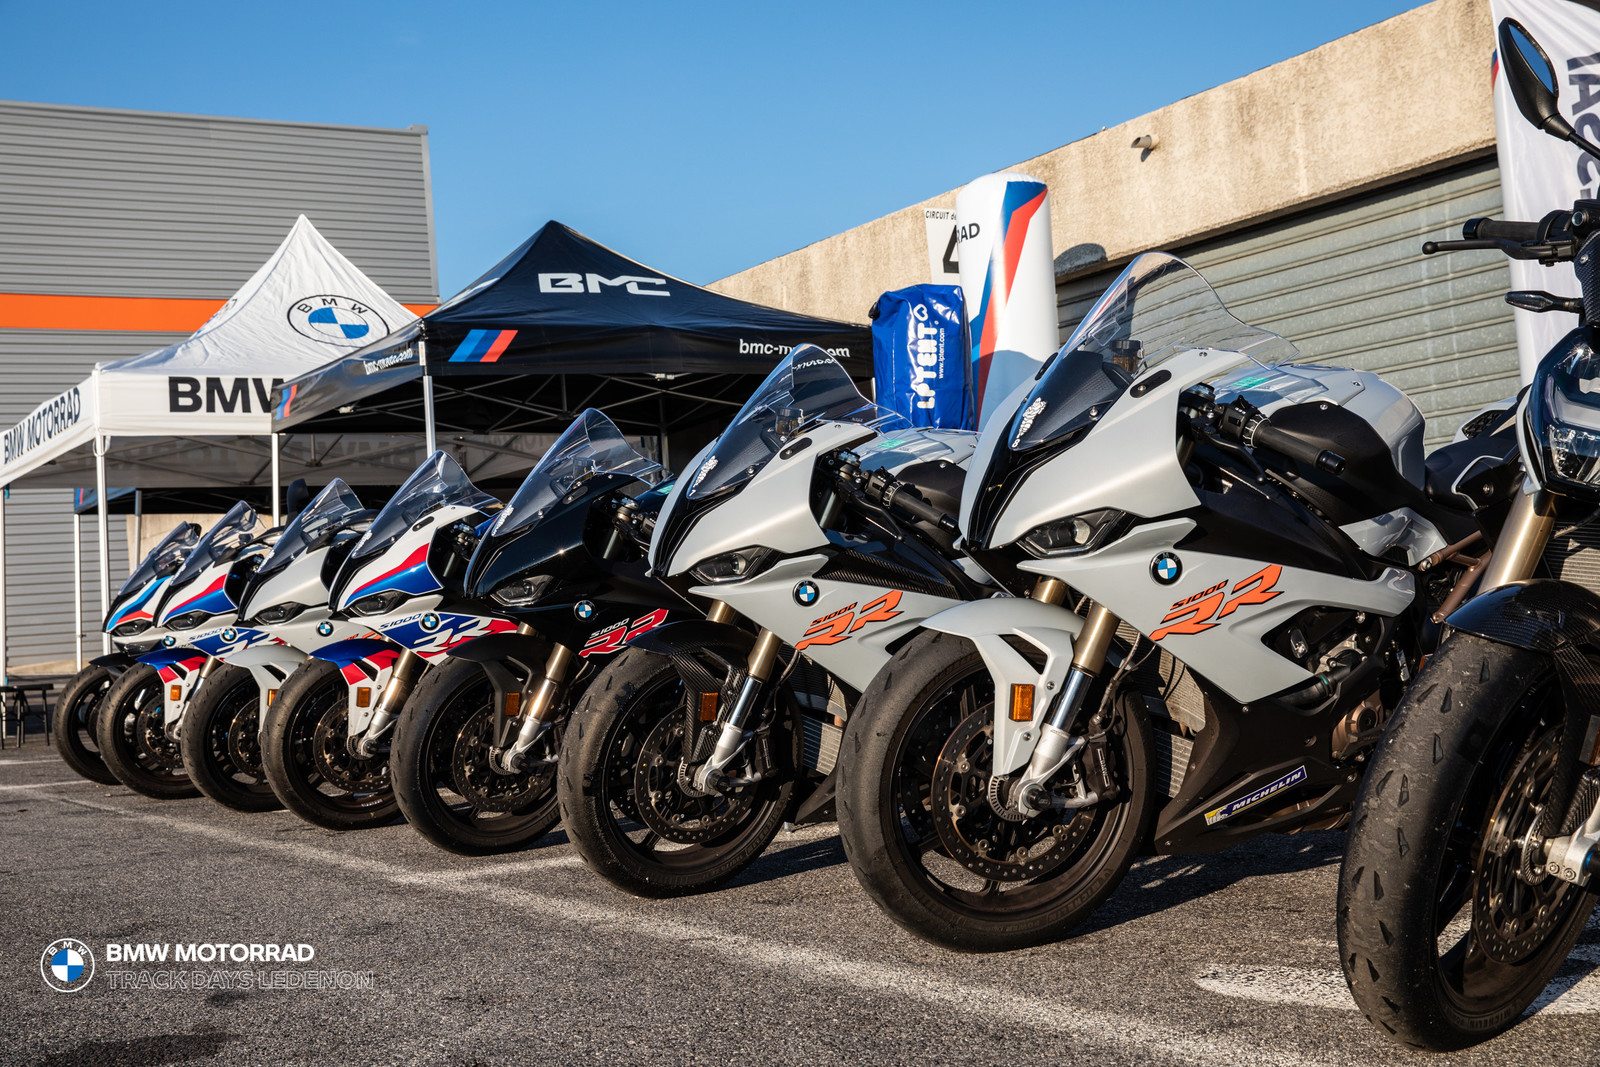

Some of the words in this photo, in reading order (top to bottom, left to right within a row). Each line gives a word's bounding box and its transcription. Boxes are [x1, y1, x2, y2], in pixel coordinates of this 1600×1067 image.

[925, 210, 950, 220] CIRCUIT
[538, 272, 671, 297] BMC
[297, 297, 368, 315] BMW
[3, 422, 26, 465] BMW
[26, 386, 81, 452] MOTORRAD
[1150, 565, 1284, 642] RR
[1169, 579, 1229, 612] S1000
[378, 613, 422, 630] S1000
[795, 590, 904, 651] RR
[810, 601, 858, 627] S1000
[590, 617, 630, 639] S1000
[1232, 770, 1302, 811] MICHELIN
